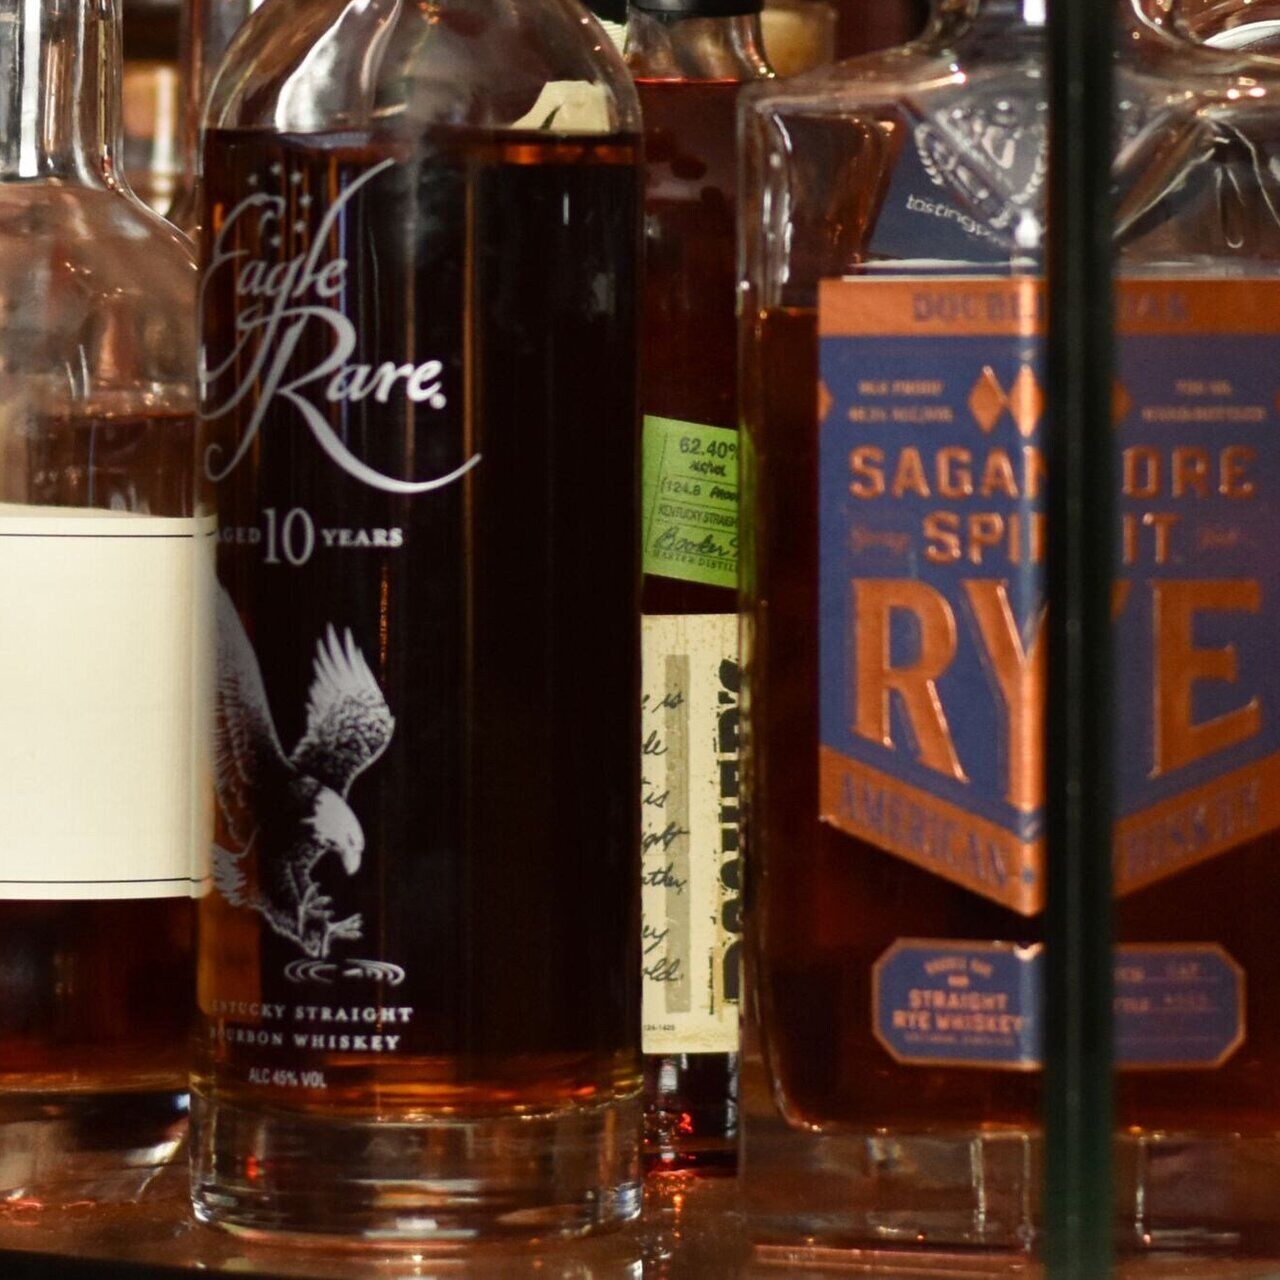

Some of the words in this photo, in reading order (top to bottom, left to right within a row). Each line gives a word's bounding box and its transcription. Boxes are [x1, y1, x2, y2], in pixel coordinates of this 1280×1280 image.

[263, 507, 315, 567] 10
[322, 527, 404, 548] YEARS
[294, 1005, 414, 1023] STRAIGHT
[293, 1033, 402, 1052] WHISKEY
